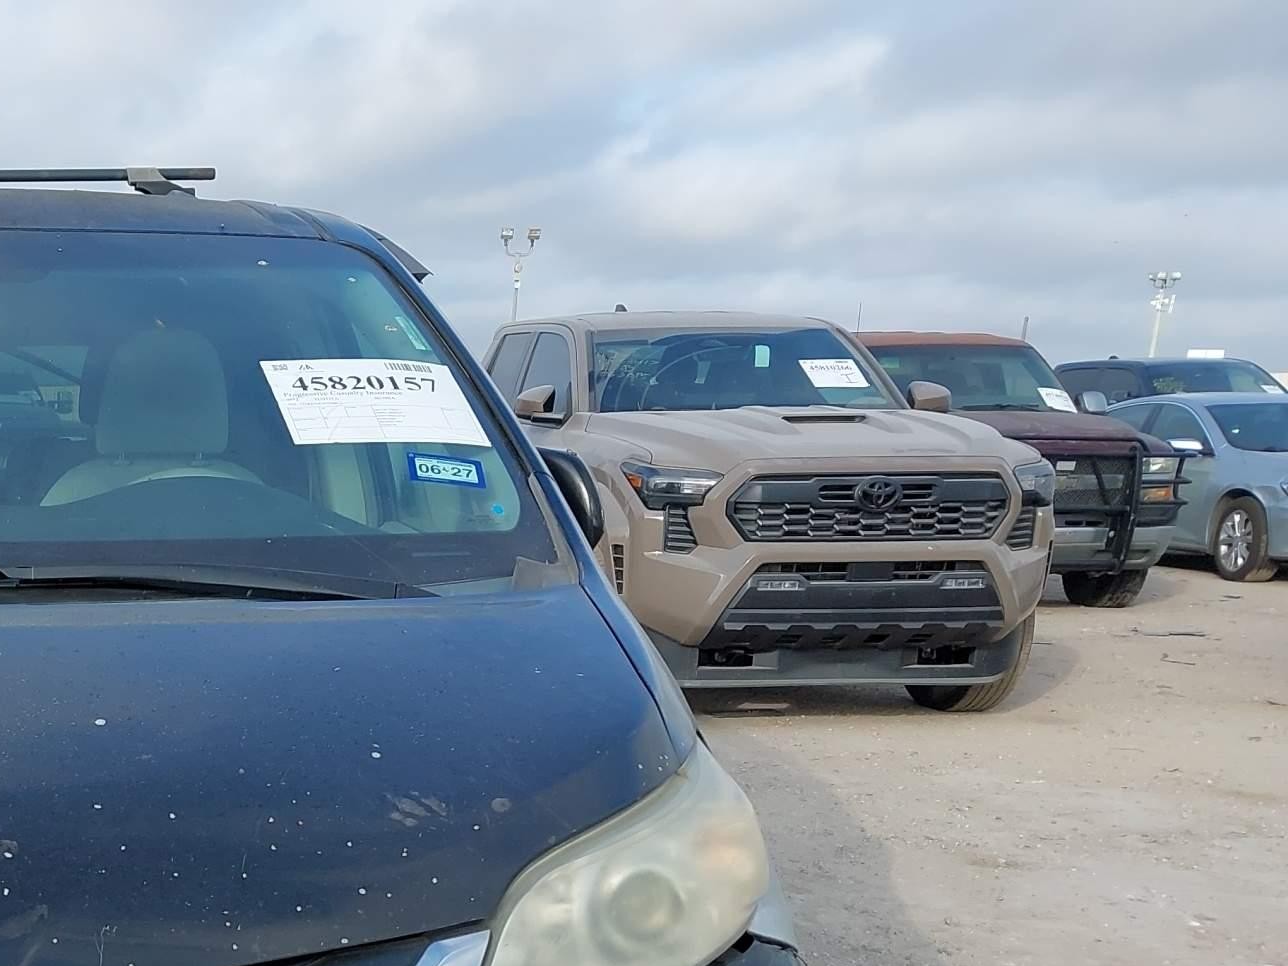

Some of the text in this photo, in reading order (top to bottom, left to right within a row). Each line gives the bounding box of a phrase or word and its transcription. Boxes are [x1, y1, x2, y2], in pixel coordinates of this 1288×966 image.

[292, 375, 435, 392] 45820157
[418, 463, 473, 478] 06 27
